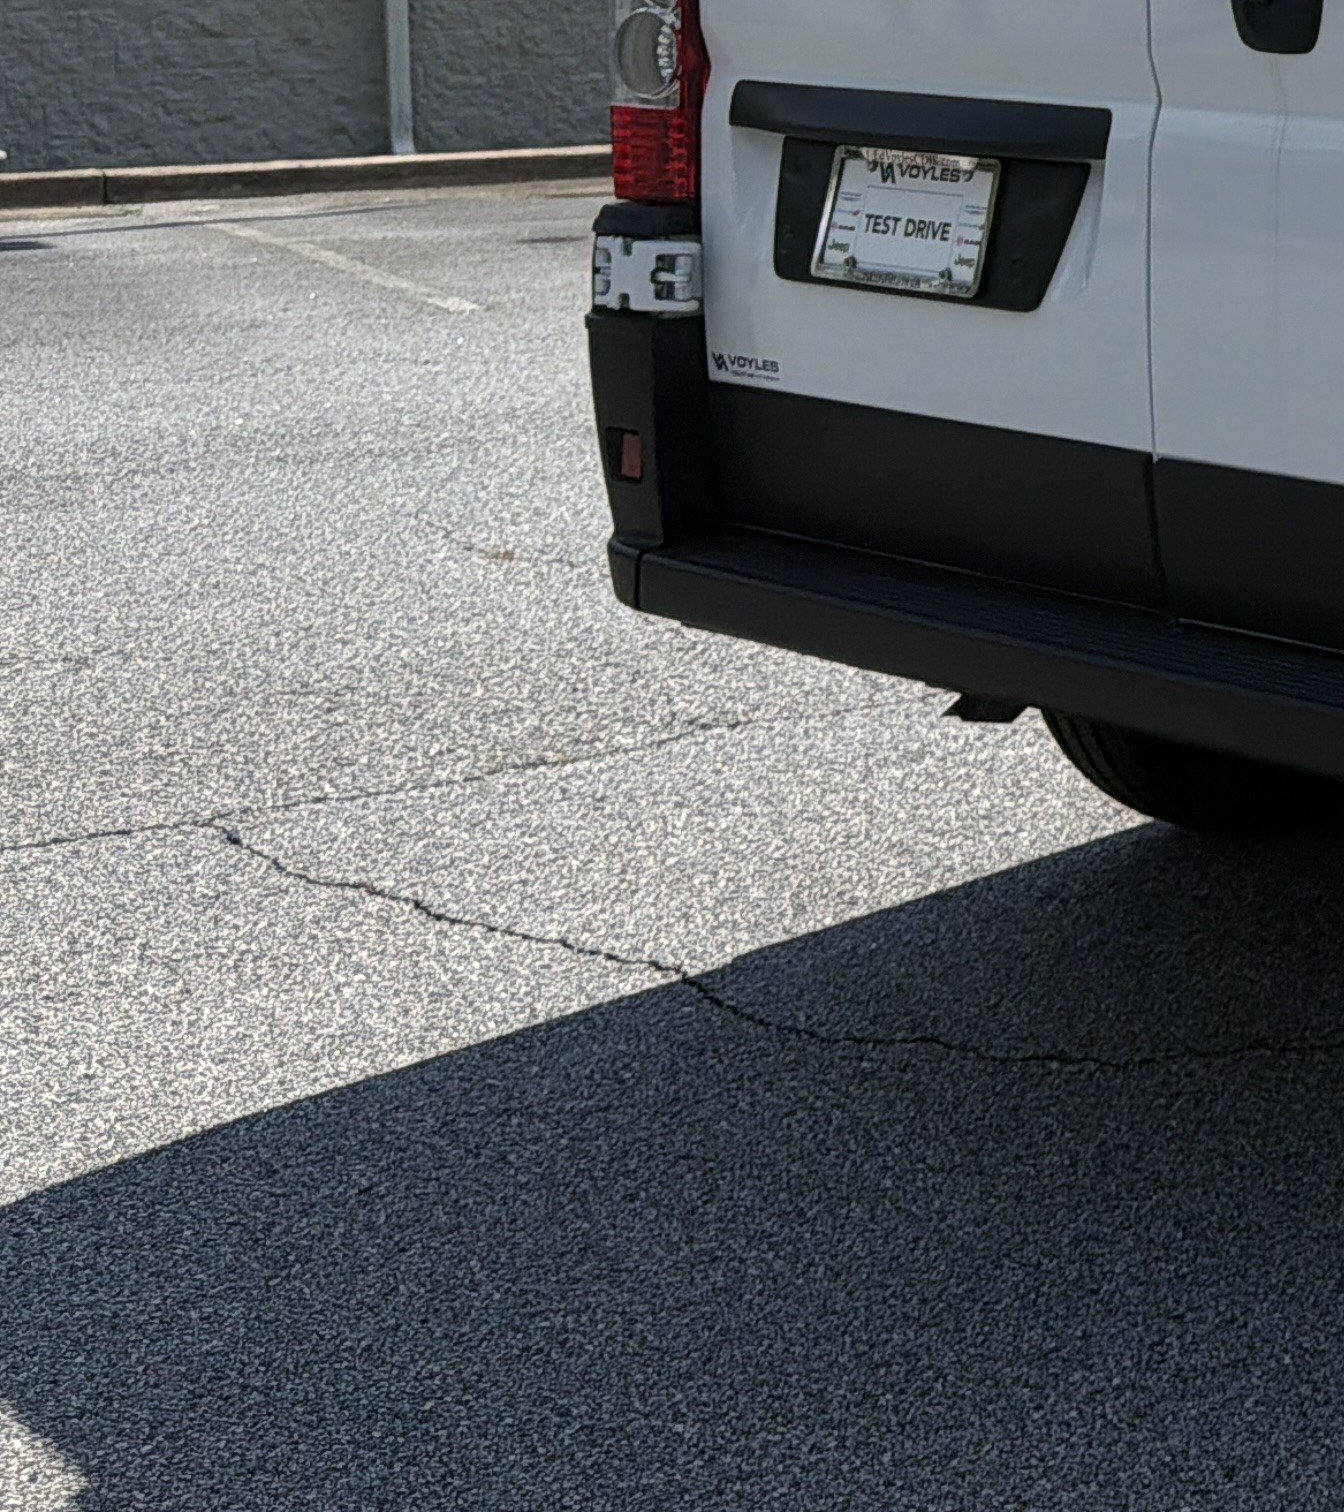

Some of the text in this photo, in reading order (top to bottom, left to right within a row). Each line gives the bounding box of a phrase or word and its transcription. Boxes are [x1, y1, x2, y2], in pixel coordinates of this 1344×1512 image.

[896, 162, 961, 183] VOYLES
[864, 213, 902, 236] TEST
[903, 218, 952, 242] DRIVE
[728, 354, 779, 372] VOYLES
